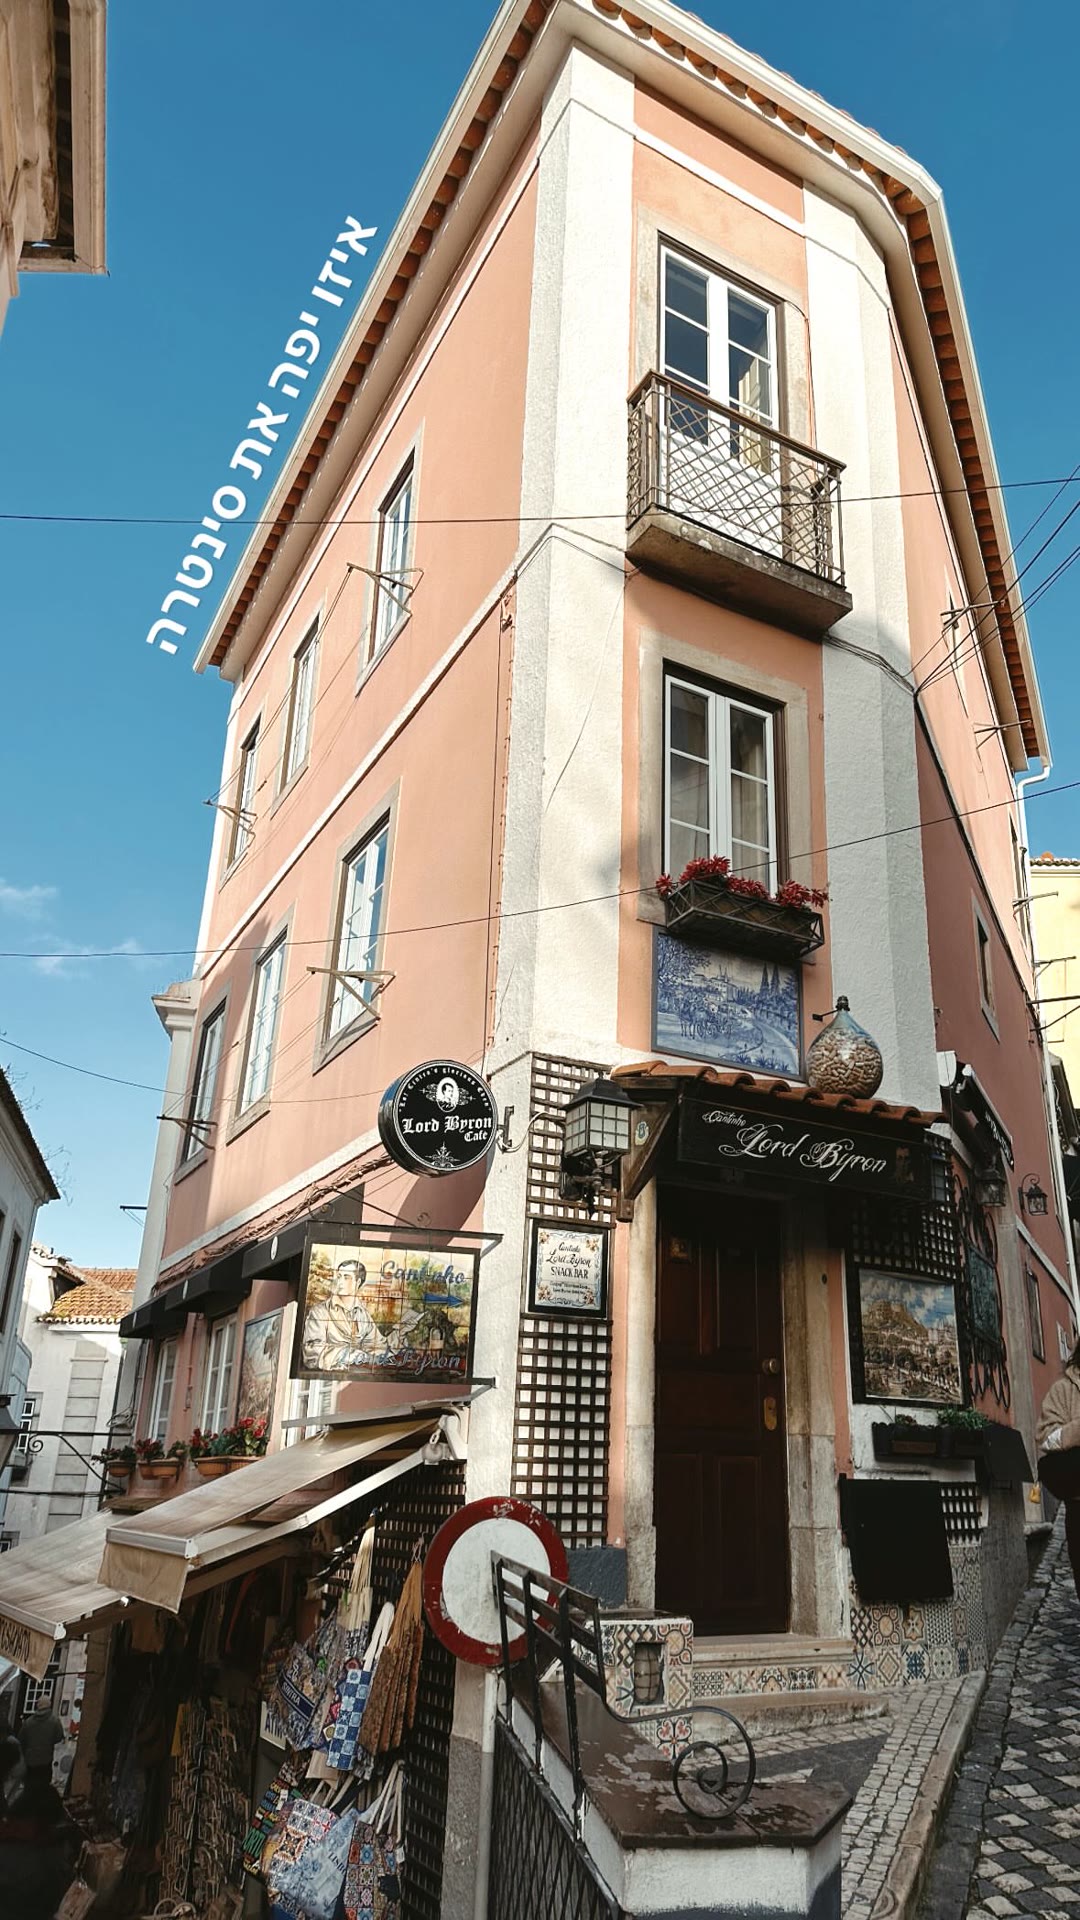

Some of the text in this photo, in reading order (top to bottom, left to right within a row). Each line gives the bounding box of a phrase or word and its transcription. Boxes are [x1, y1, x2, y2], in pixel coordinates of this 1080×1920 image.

[401, 1115, 492, 1134] Lord Byron
[718, 1123, 887, 1182] Lord Byron
[545, 1248, 566, 1265] Lord
[381, 1260, 466, 1285] Cantinho
[550, 1266, 589, 1280] SNACK BAR
[281, 1681, 301, 1706] SINTRA
